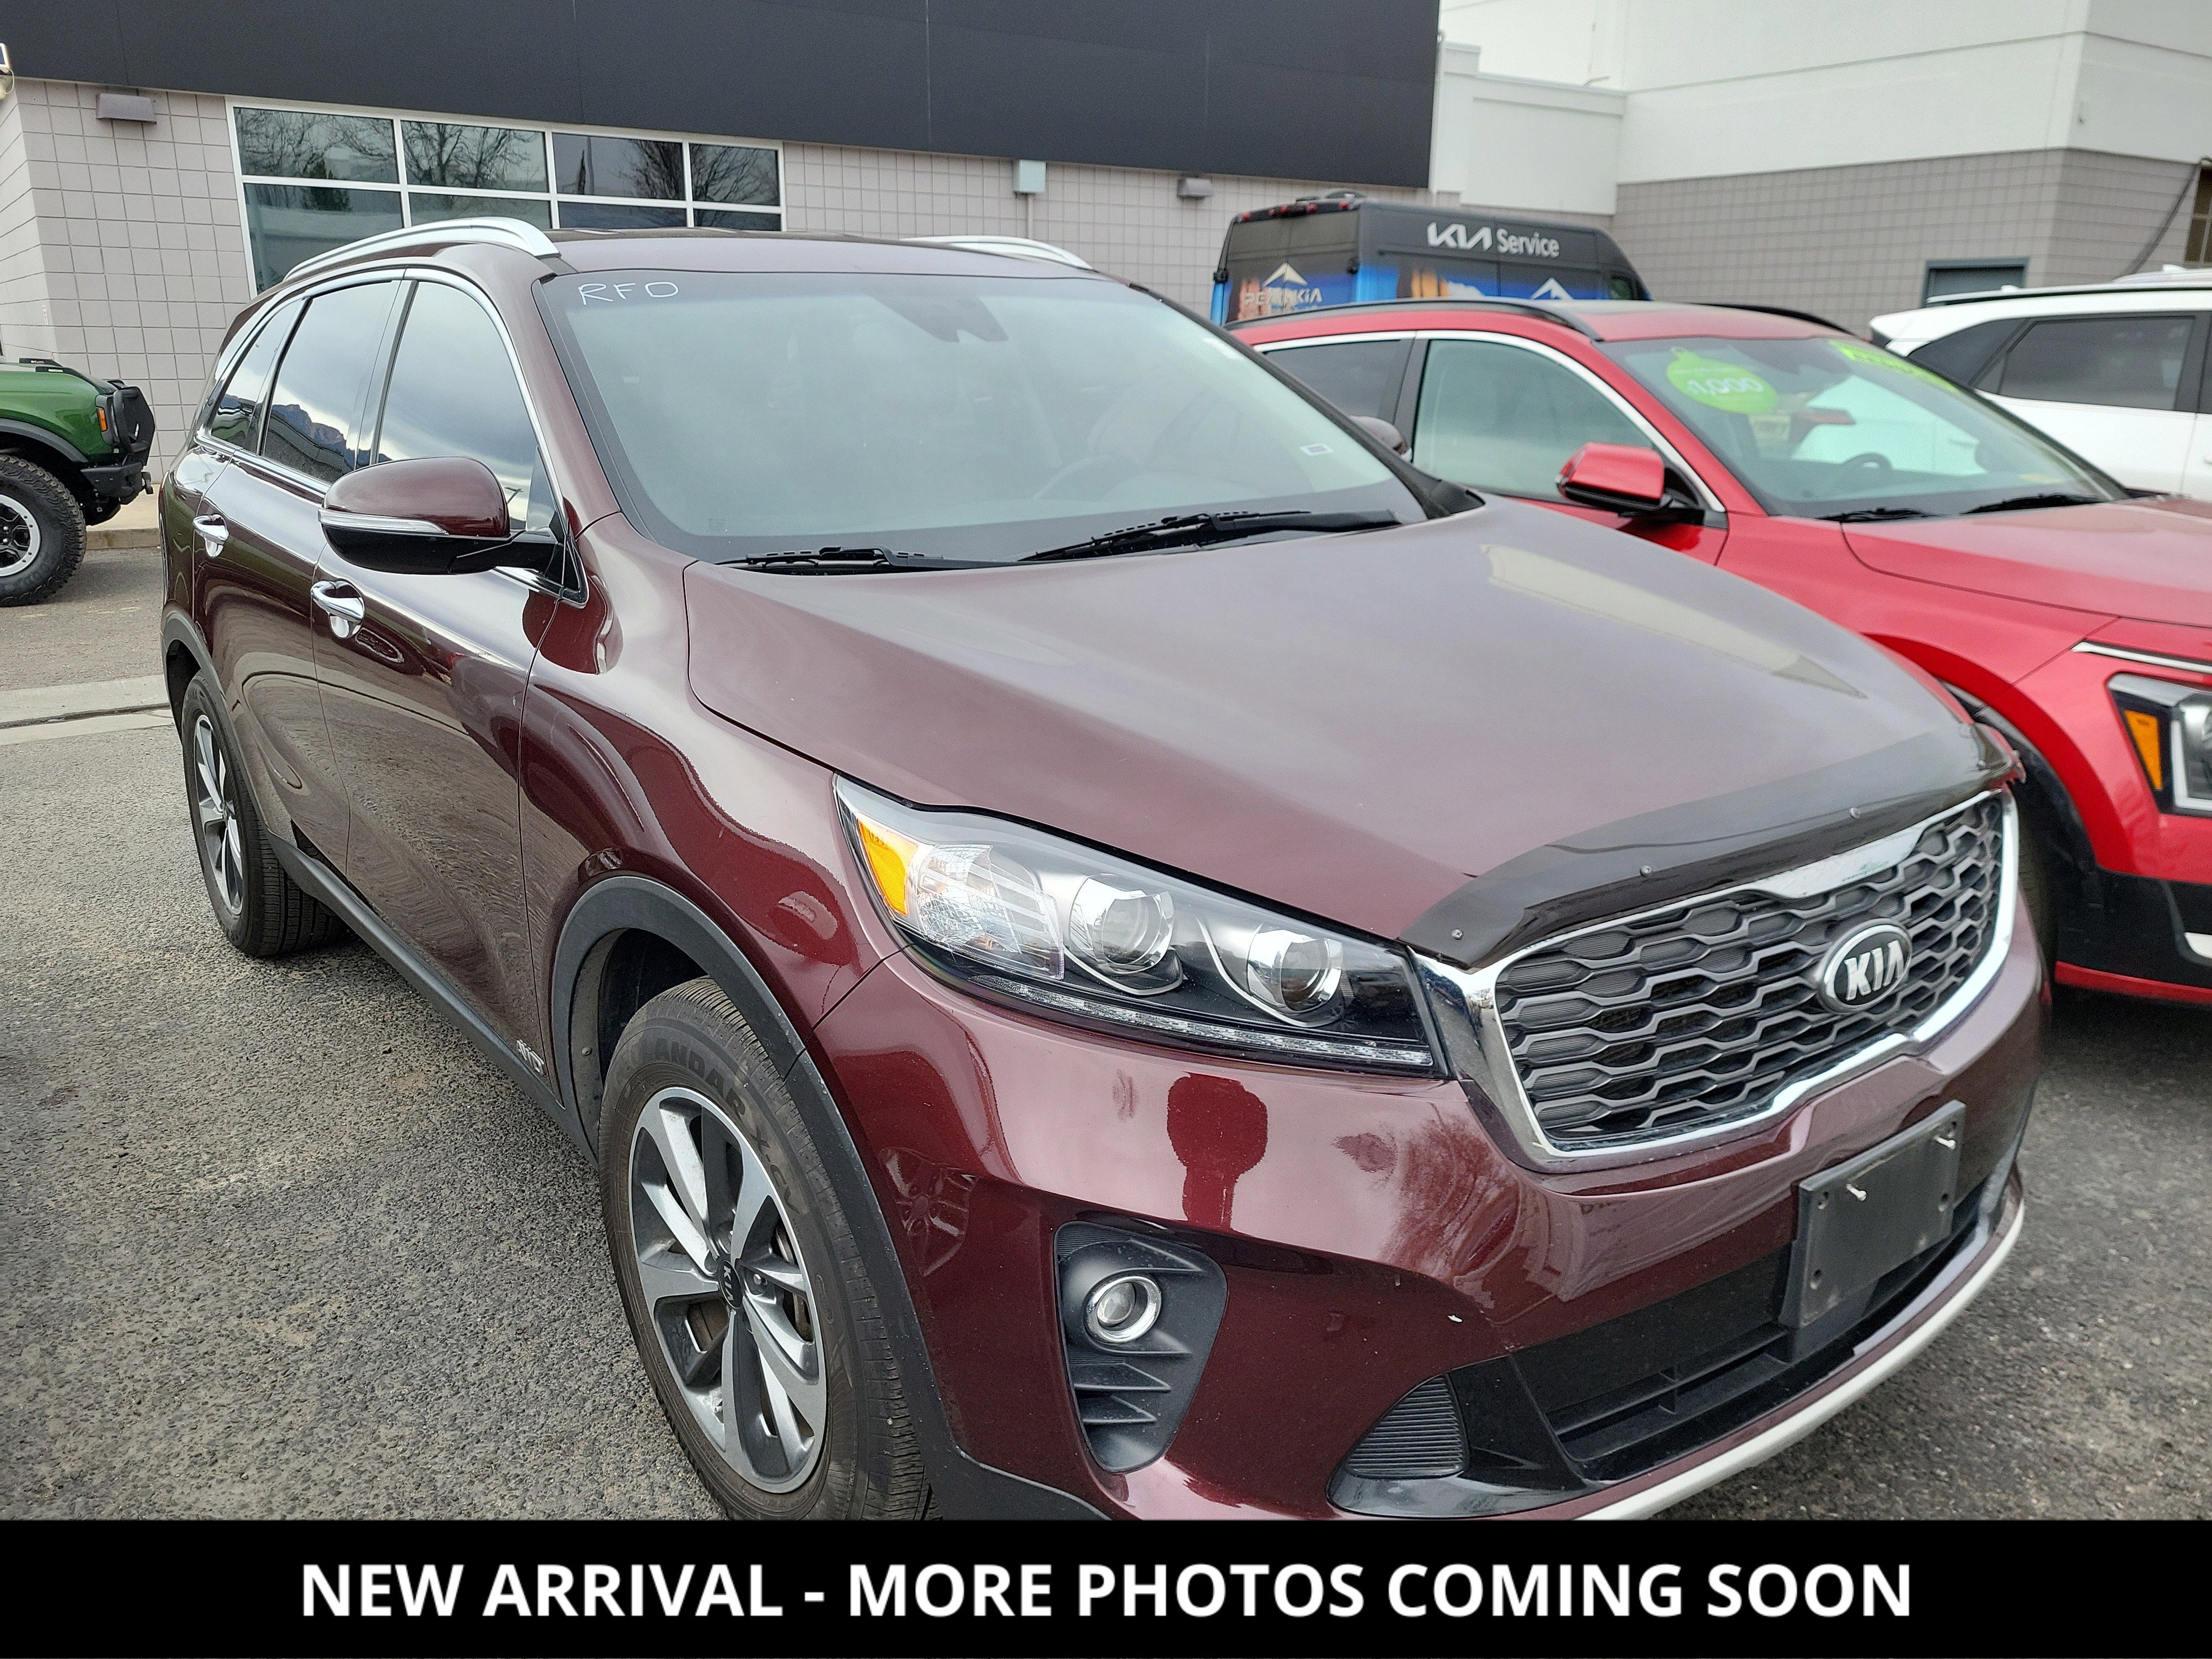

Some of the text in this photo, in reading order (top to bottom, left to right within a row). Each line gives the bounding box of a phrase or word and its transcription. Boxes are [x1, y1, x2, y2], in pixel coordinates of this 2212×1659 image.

[1427, 222, 1560, 258] KIA Service
[1844, 940, 1905, 1001] KIA
[723, 1265, 734, 1301] KIA
